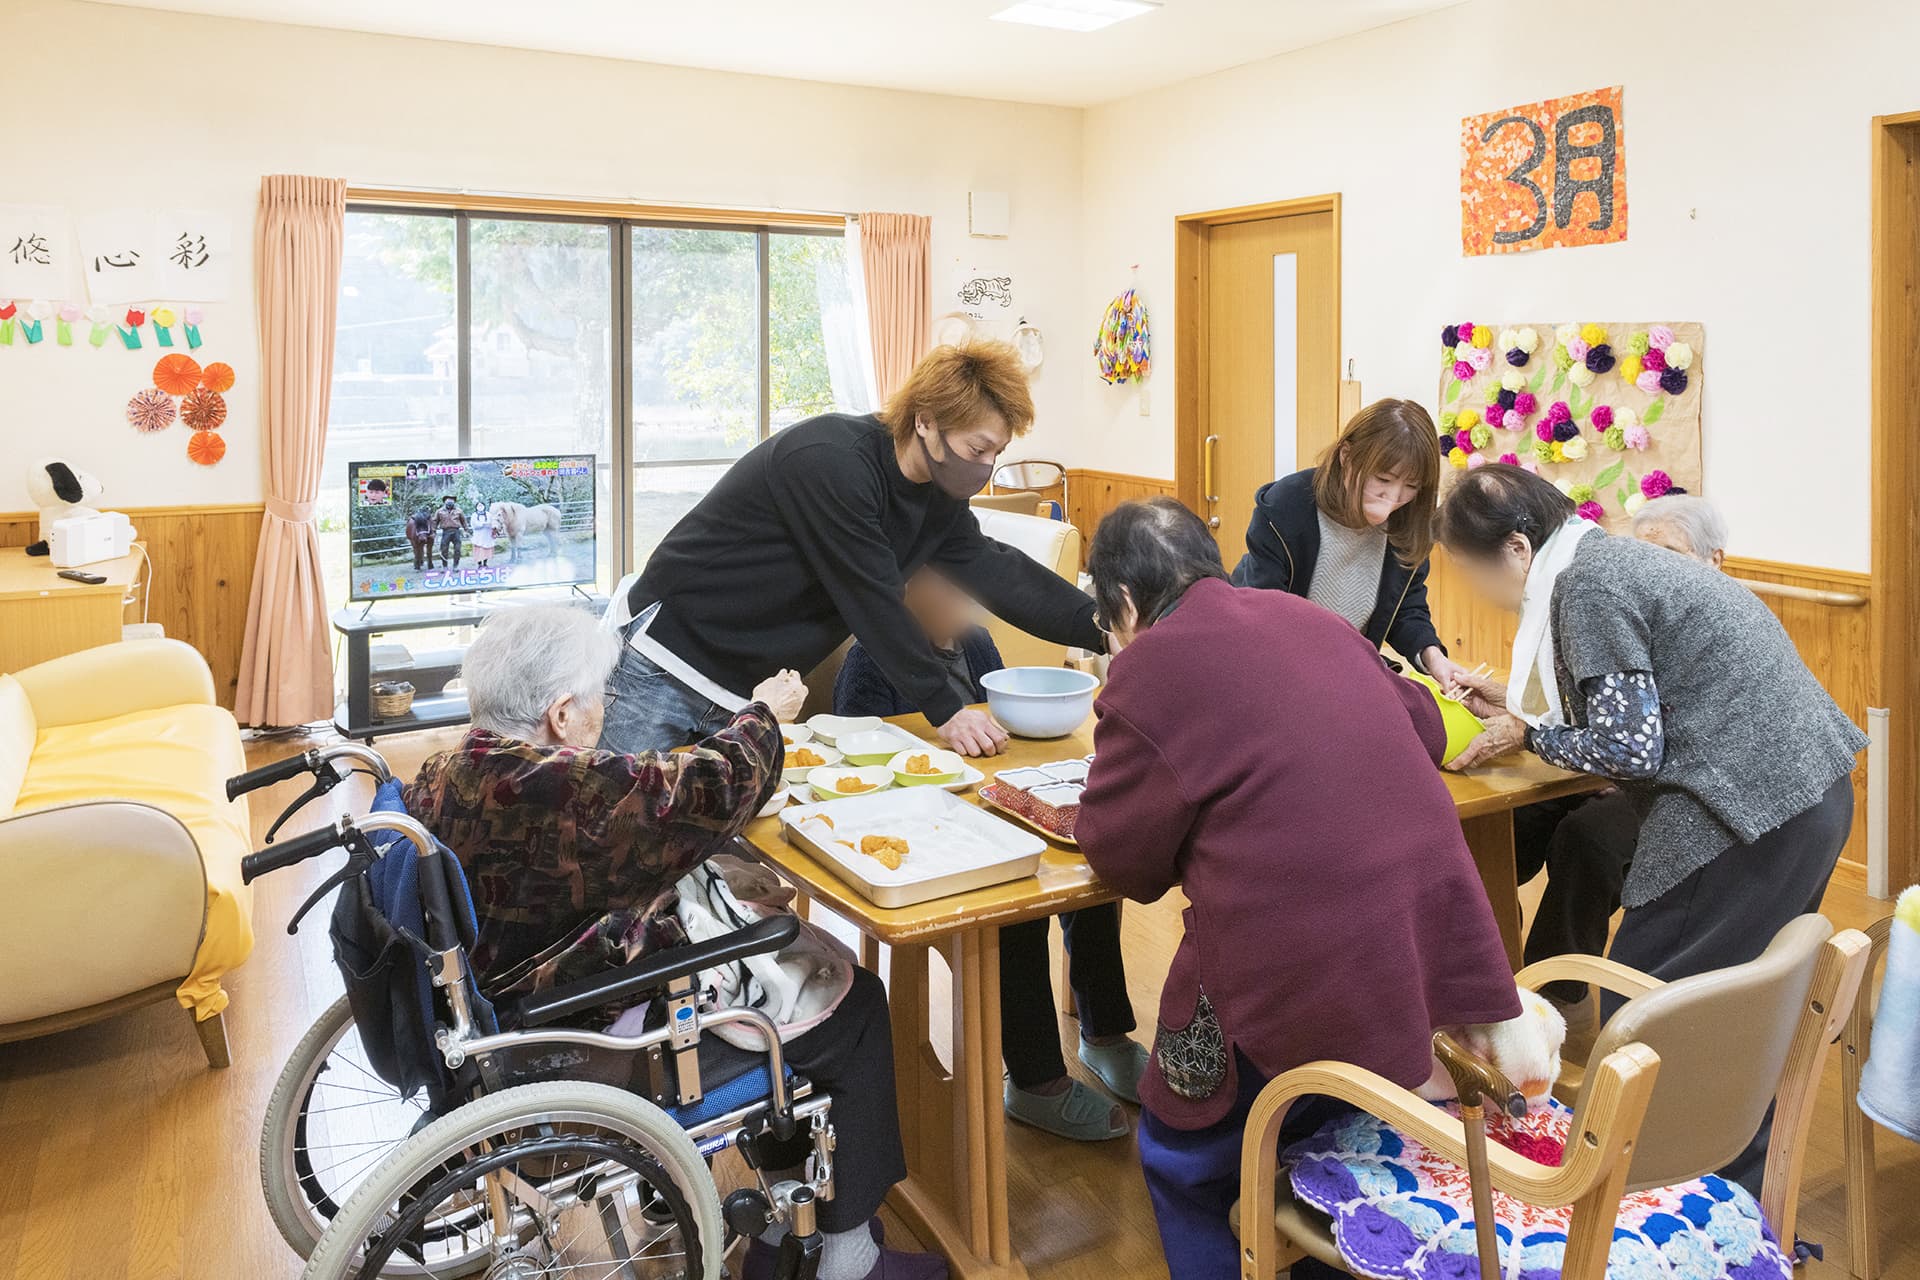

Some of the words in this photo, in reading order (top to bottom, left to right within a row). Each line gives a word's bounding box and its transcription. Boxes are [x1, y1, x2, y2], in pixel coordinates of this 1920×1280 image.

[1481, 104, 1616, 244] 3月
[8, 232, 50, 265] 悠
[94, 249, 140, 273] 心
[169, 231, 210, 269] 彩
[424, 567, 511, 589] こんにちは
[698, 1136, 724, 1152] MURA
